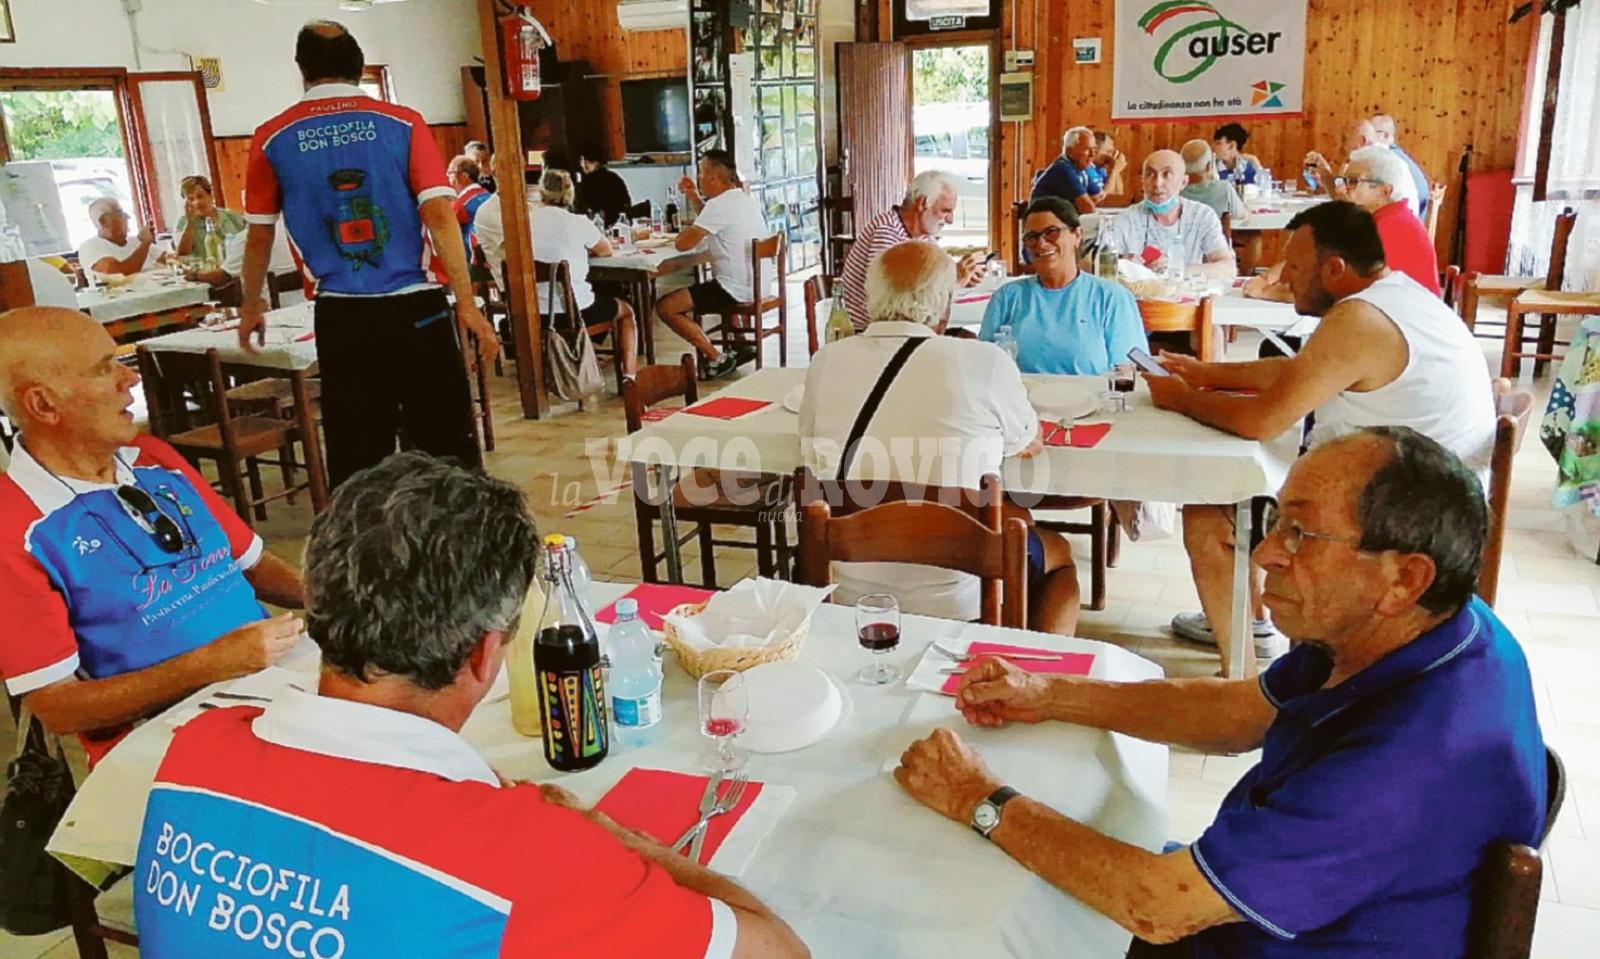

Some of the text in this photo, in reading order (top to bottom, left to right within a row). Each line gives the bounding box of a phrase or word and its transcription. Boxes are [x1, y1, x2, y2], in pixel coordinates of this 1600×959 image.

[932, 17, 962, 27] USCITA
[1188, 31, 1282, 58] auser
[1139, 99, 1192, 110] cittadinanza
[1194, 99, 1211, 108] non
[1213, 96, 1225, 107] ha
[297, 120, 375, 141] BOCCIOFILA
[299, 130, 377, 152] DON BOSCO
[155, 821, 350, 921] BOCCIOFILA
[146, 859, 346, 959] DON BOSCO
